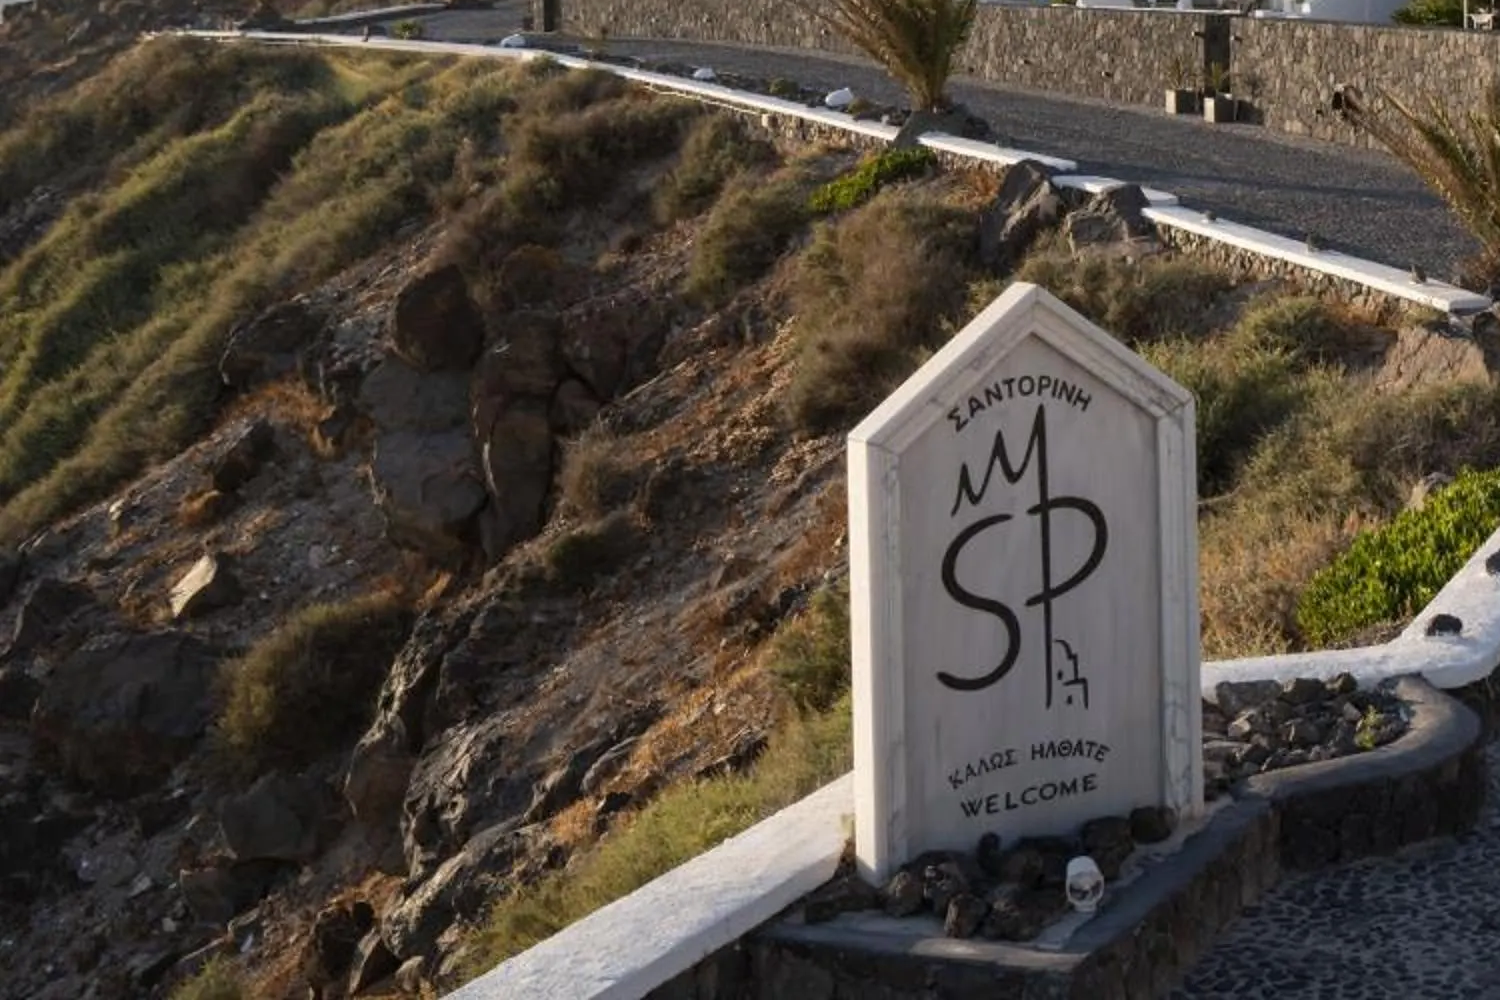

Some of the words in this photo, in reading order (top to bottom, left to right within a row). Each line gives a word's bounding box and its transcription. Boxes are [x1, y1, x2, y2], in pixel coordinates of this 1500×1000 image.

[947, 375, 1092, 432] ΣΑΝΤΟΡΙΝΗ
[948, 749, 1017, 790] ΚΑΛΩΣ
[1031, 739, 1111, 763] ΗΛΘΑΤΕ
[960, 773, 1098, 818] WELCOME
